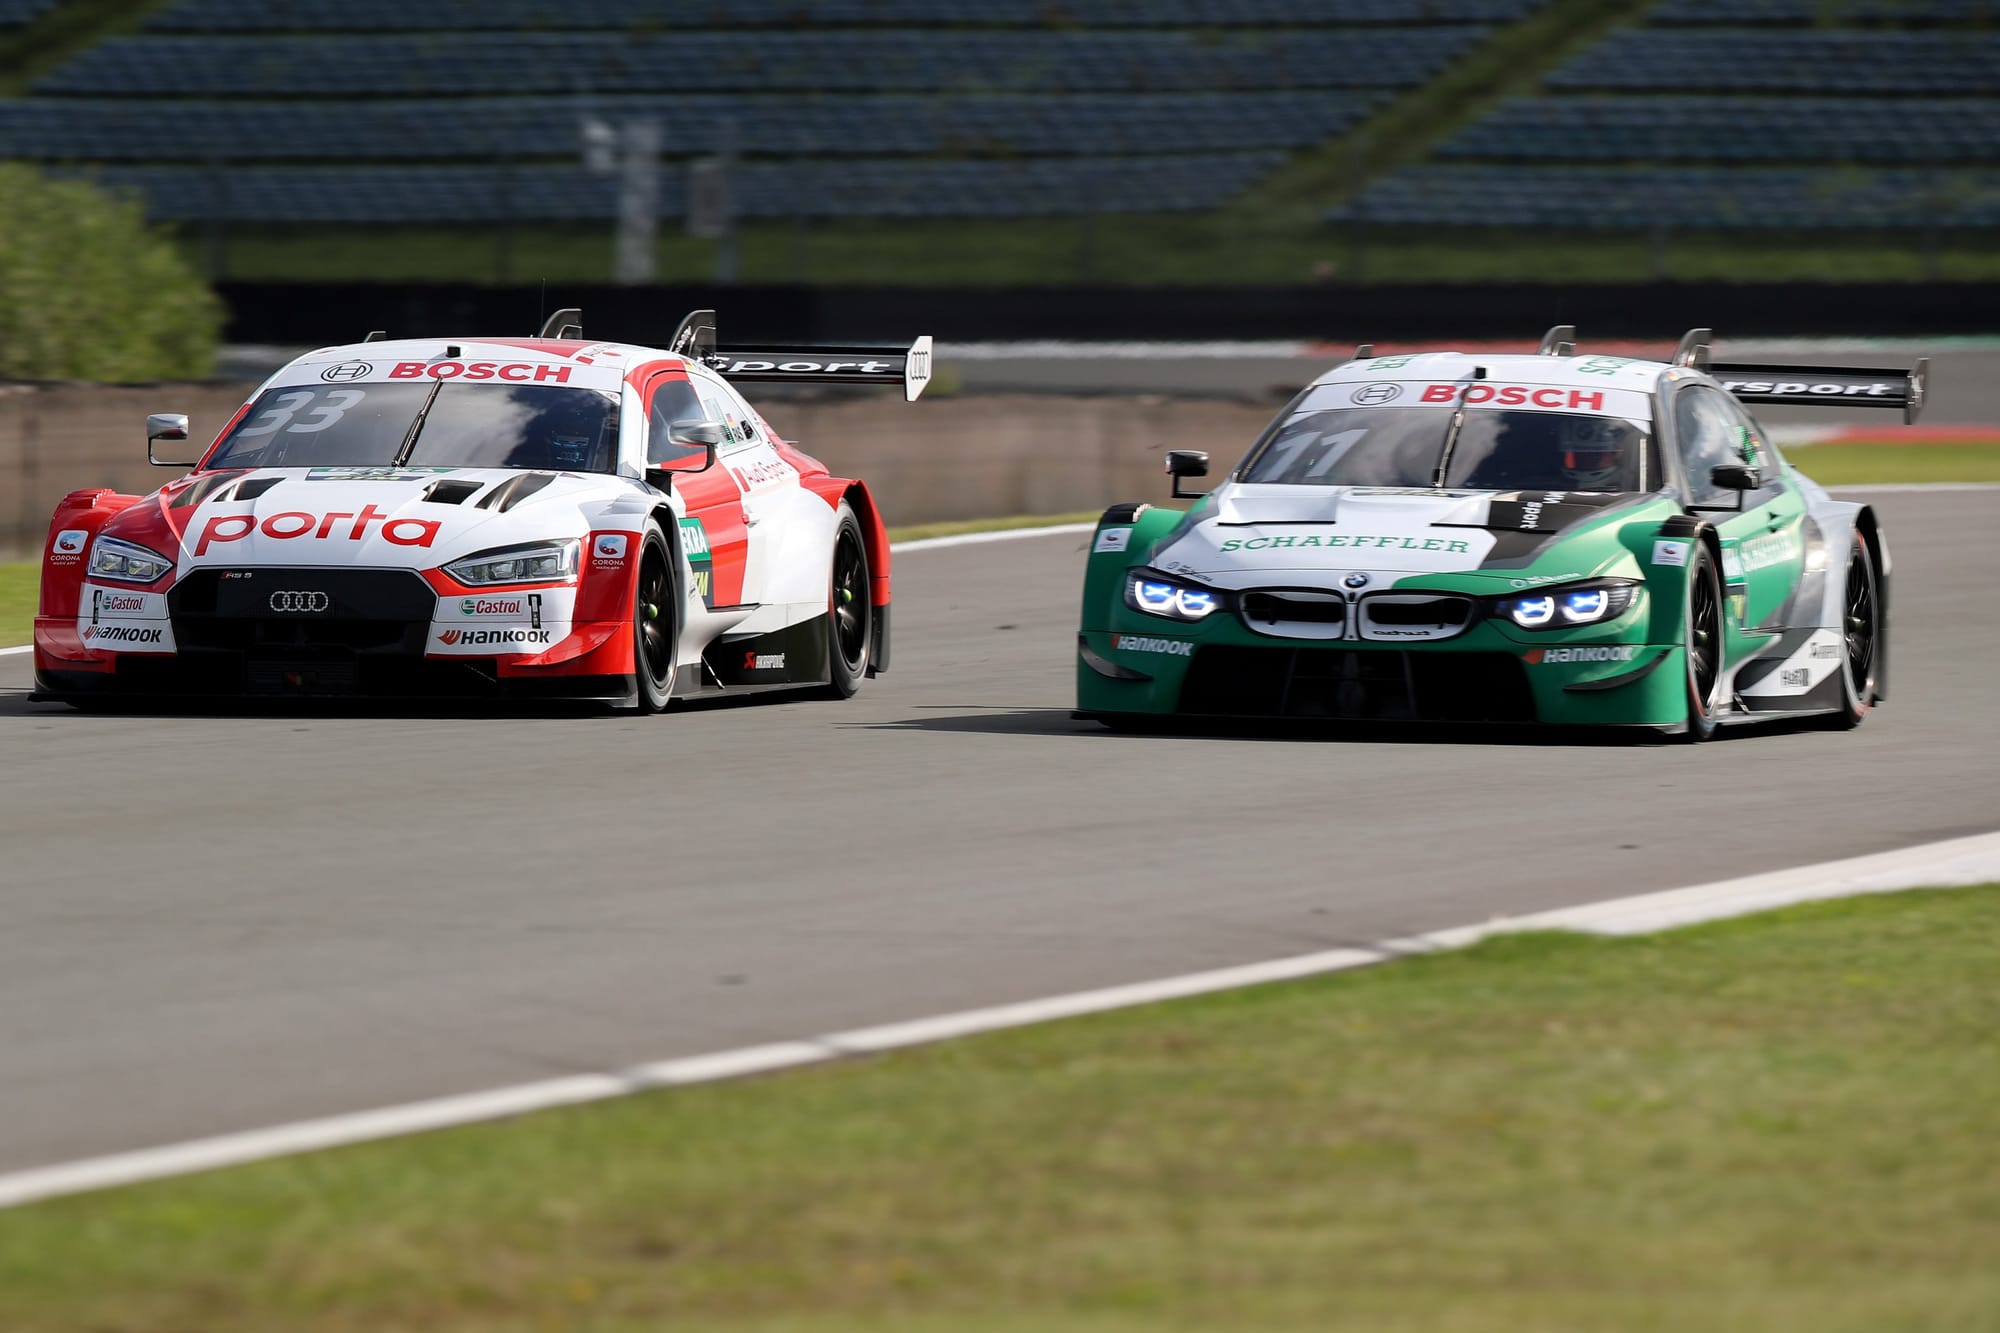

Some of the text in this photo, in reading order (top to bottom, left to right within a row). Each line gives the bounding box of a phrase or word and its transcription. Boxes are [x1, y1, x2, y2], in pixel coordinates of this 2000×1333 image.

[388, 362, 573, 383] BOSCH
[1419, 385, 1604, 411] BOSCH
[237, 390, 366, 438] 33
[1262, 429, 1369, 482] 11
[194, 504, 442, 557] porta
[1220, 535, 1470, 553] SCHAEFFLER
[111, 596, 144, 610] Castrol
[476, 600, 521, 614] Castrol
